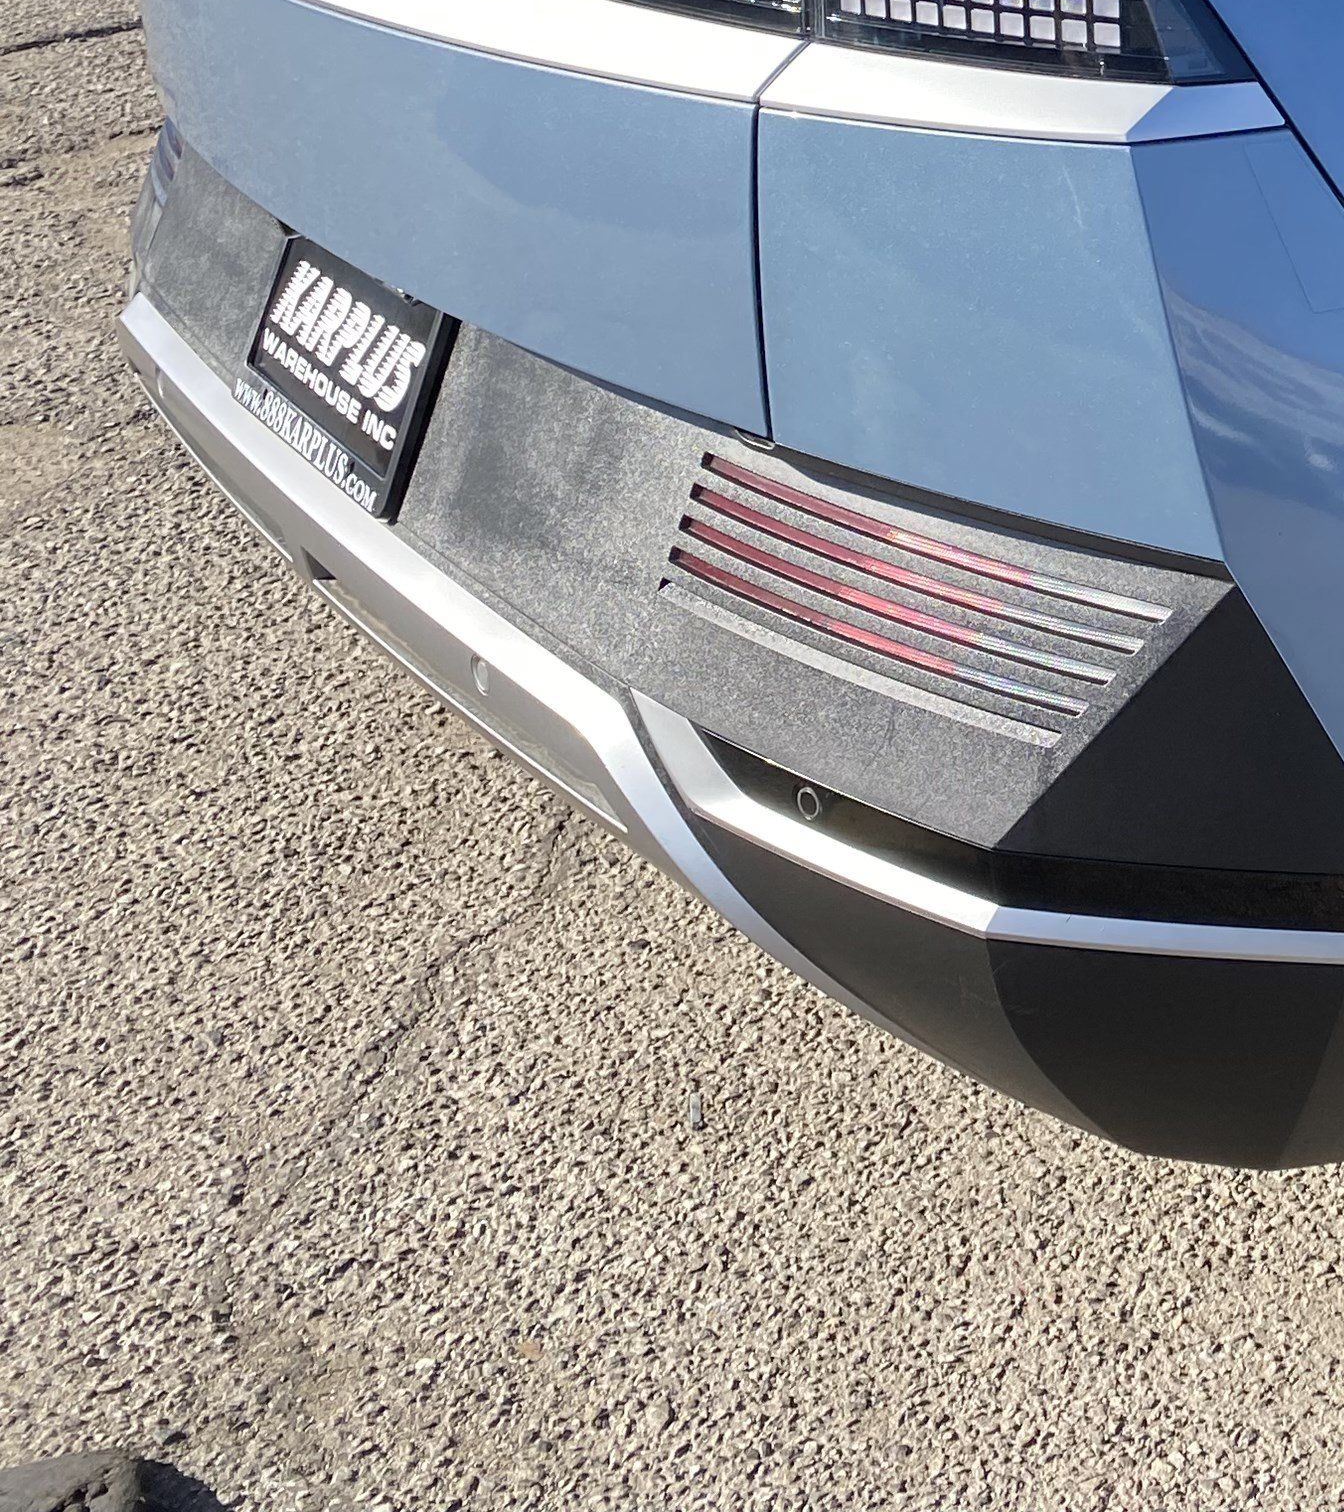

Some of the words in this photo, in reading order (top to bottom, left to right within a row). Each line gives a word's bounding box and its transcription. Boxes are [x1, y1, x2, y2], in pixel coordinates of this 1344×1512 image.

[262, 327, 363, 425] WAREHOUSE
[362, 409, 398, 451] INC
[269, 260, 427, 413] KARPLUS
